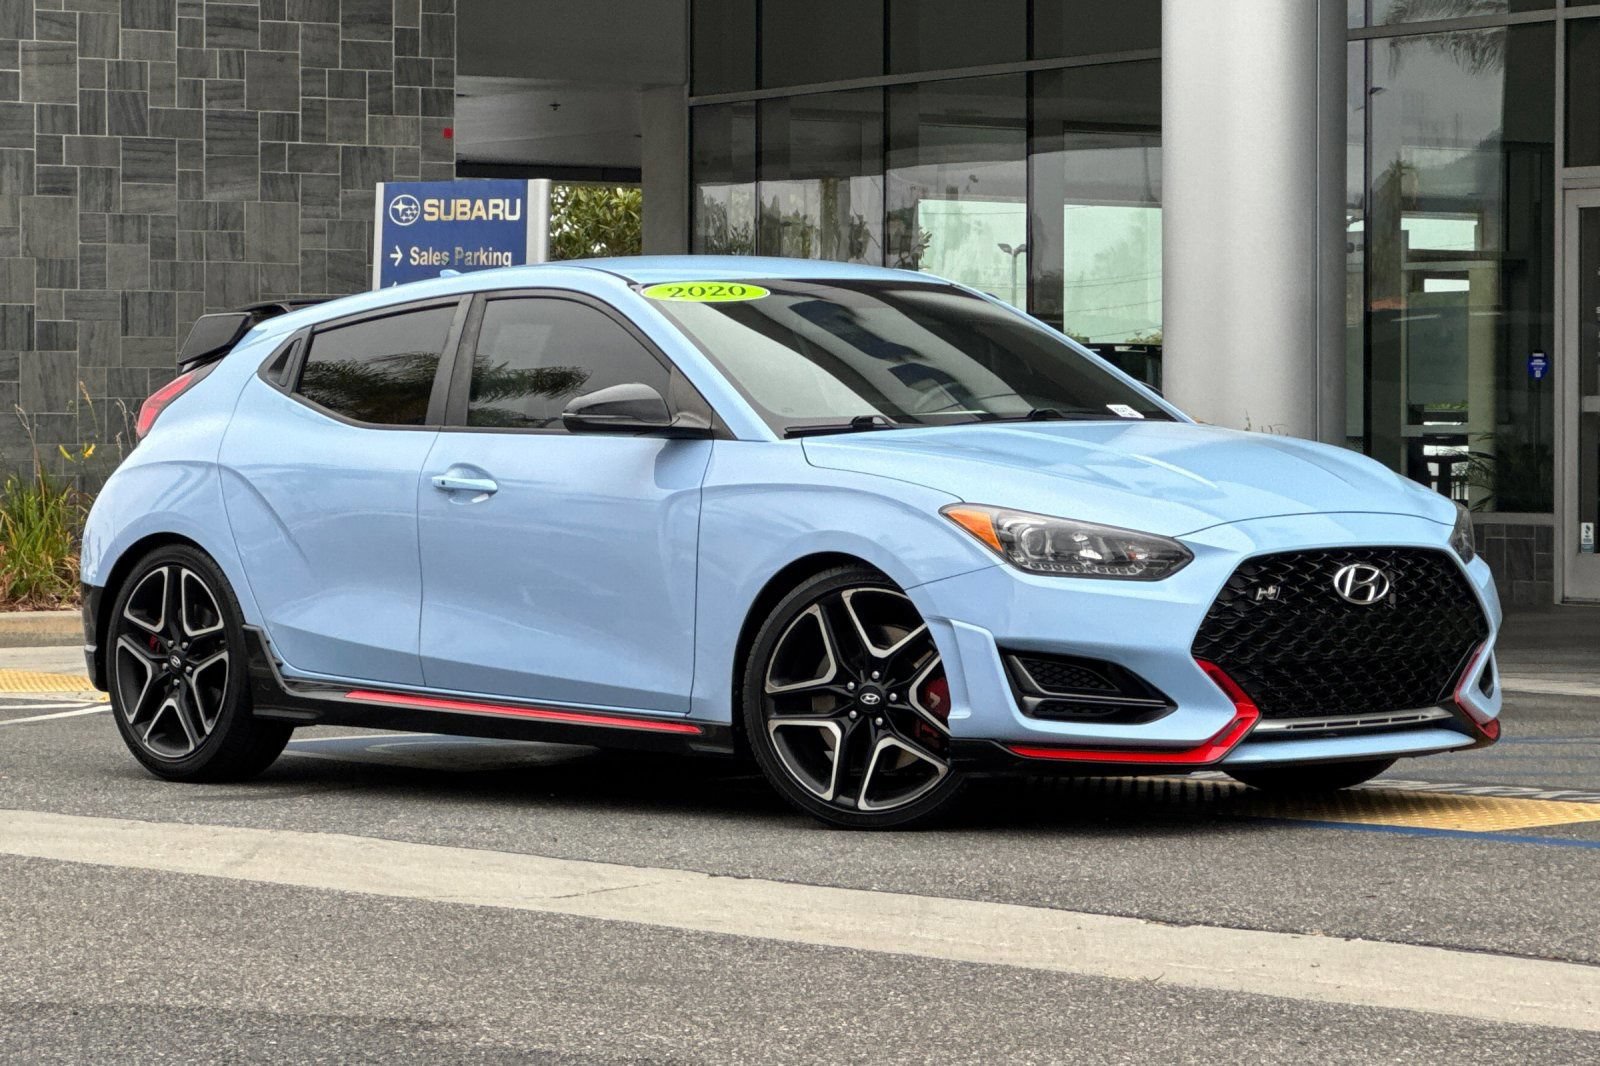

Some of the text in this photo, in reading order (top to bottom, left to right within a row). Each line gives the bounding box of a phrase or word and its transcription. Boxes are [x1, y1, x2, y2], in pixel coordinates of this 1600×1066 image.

[424, 199, 521, 221] SUBARU
[410, 246, 512, 267] Sales Parking
[667, 285, 747, 298] 2020
